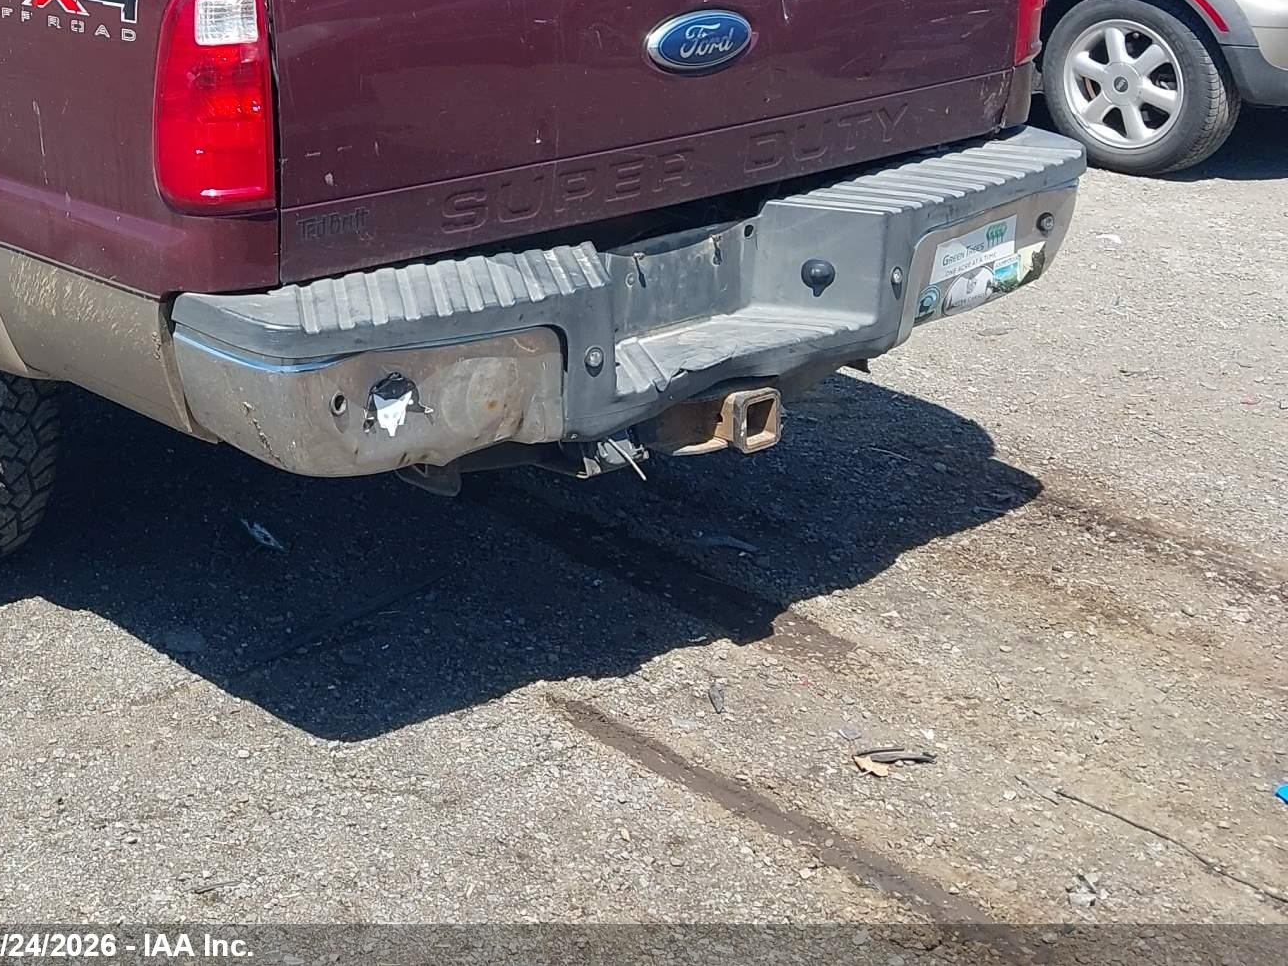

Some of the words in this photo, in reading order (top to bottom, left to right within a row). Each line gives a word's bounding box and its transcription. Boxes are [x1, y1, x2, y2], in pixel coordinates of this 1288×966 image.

[47, 15, 137, 42] ROAD
[679, 22, 735, 59] Ford
[440, 146, 695, 234] SUPER
[744, 101, 909, 175] DUTY
